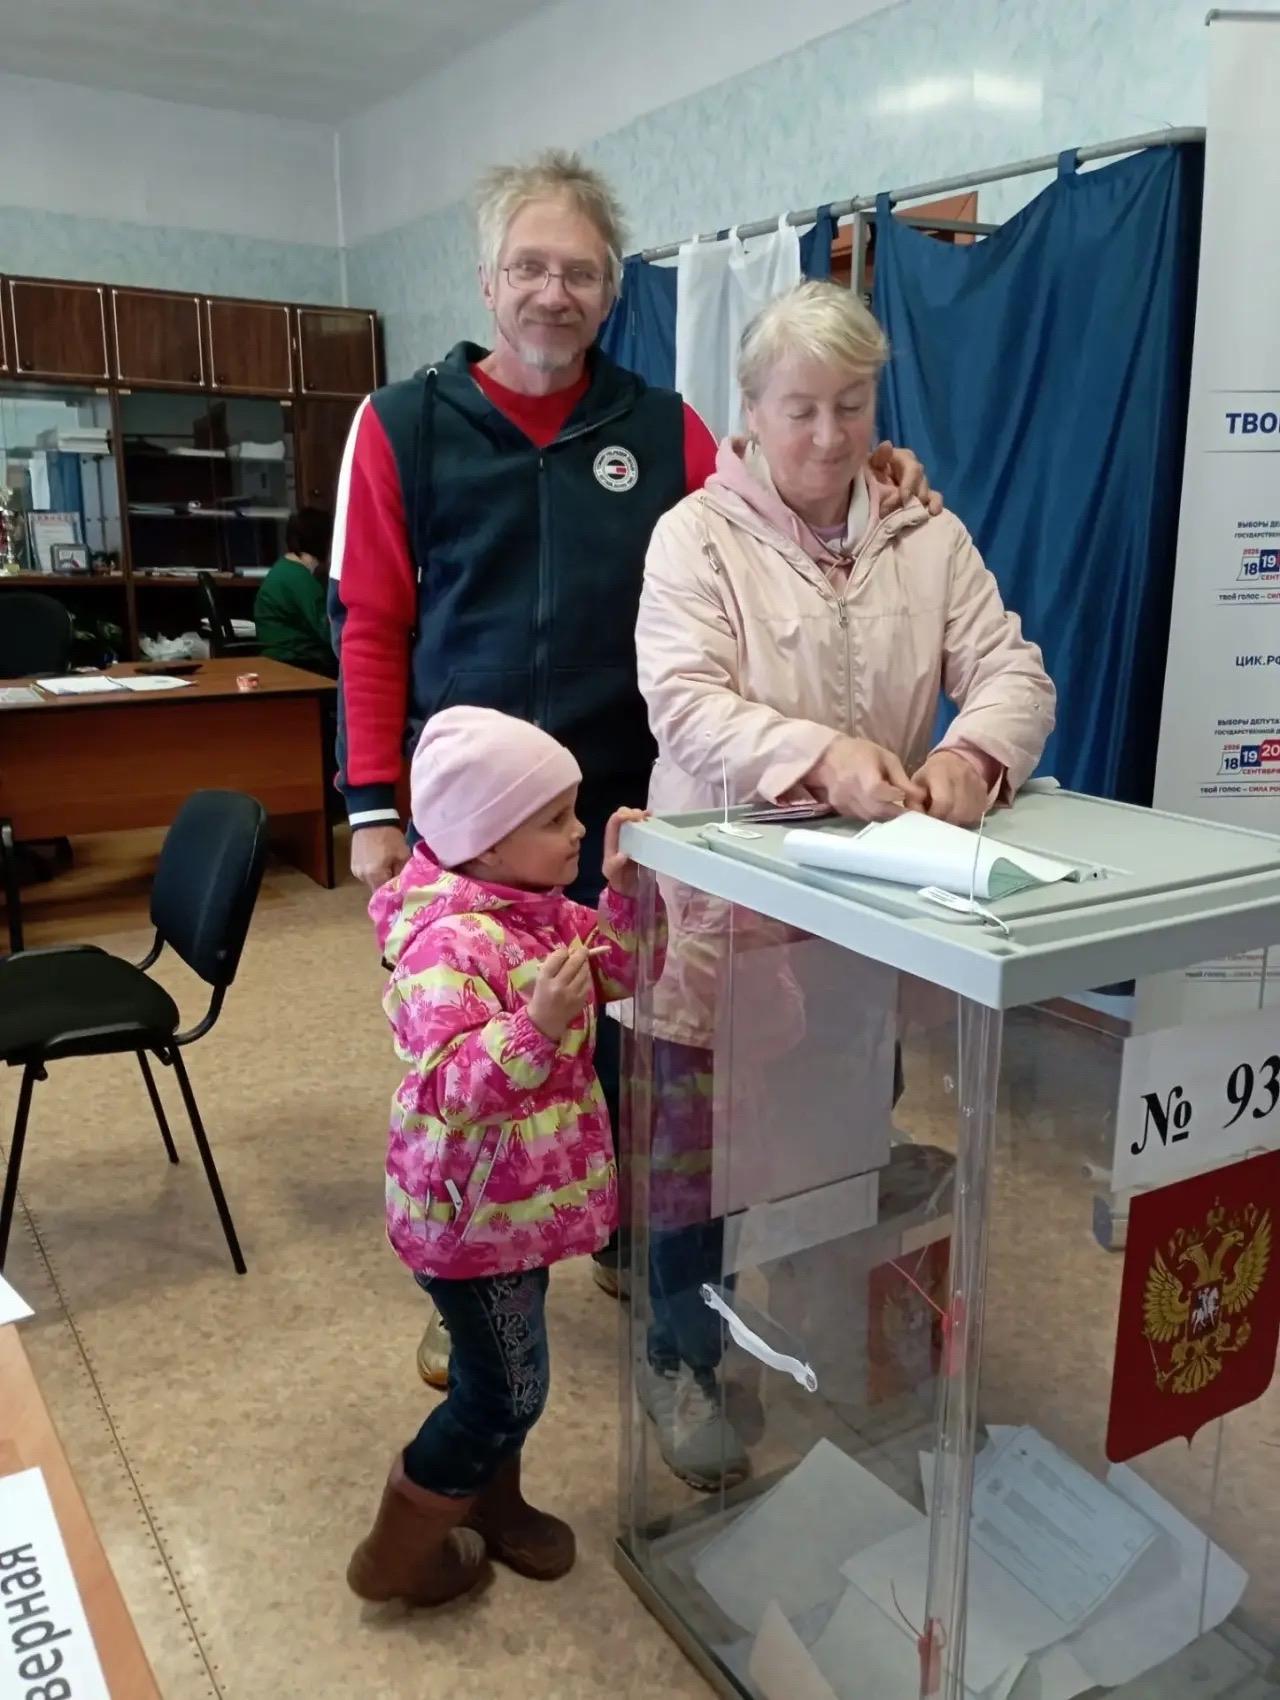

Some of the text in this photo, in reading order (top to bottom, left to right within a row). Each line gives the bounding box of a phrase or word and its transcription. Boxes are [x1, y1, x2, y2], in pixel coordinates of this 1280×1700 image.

[1225, 412, 1280, 434] ТВО
[1237, 520, 1269, 529] ВЫБОРЫ
[1243, 554, 1276, 576] 18 19
[1224, 744, 1280, 770] 18 19 20
[1200, 785, 1217, 794] ТВОЙ
[1218, 785, 1241, 793] ГОЛОС
[1248, 785, 1268, 793] СИЛА
[1130, 1085, 1192, 1155] №
